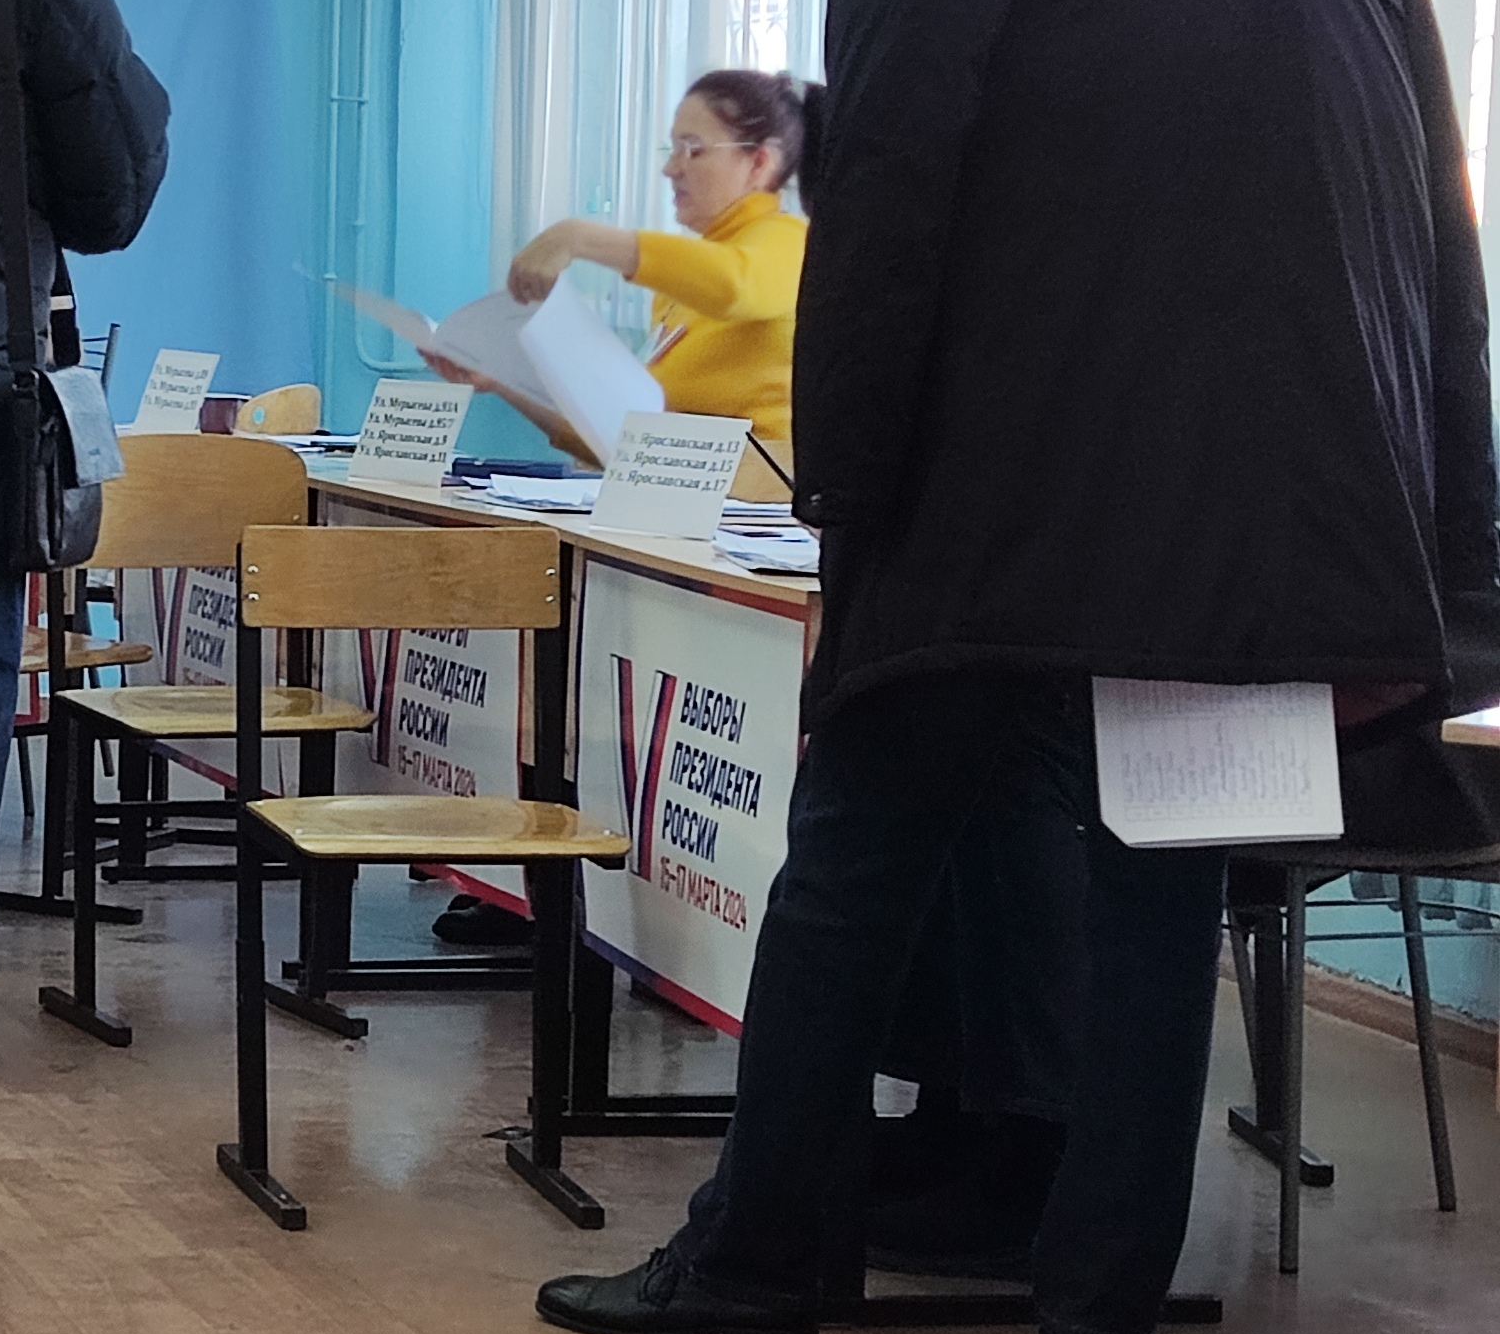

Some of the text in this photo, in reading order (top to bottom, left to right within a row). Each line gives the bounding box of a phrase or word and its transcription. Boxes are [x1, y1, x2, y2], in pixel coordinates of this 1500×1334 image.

[632, 451, 707, 469] Ярославская
[707, 459, 735, 472] д.15
[639, 432, 713, 451] Ярославская
[714, 440, 741, 454] д.13
[626, 470, 701, 489] Ярославская
[701, 478, 728, 492] д.17
[188, 584, 237, 630] ПРЕЗИДЕ
[184, 626, 226, 669] РОССИИ
[404, 648, 487, 708] ПРЕЗИДЕНТА
[399, 697, 450, 747] РОССИИ
[680, 681, 747, 744] ВЫБОРЫ
[669, 740, 762, 818] ПРЕЗИДЕНТА
[662, 799, 719, 863] РОССИИ
[687, 869, 721, 919] МАРТА
[722, 887, 747, 932] 2024
